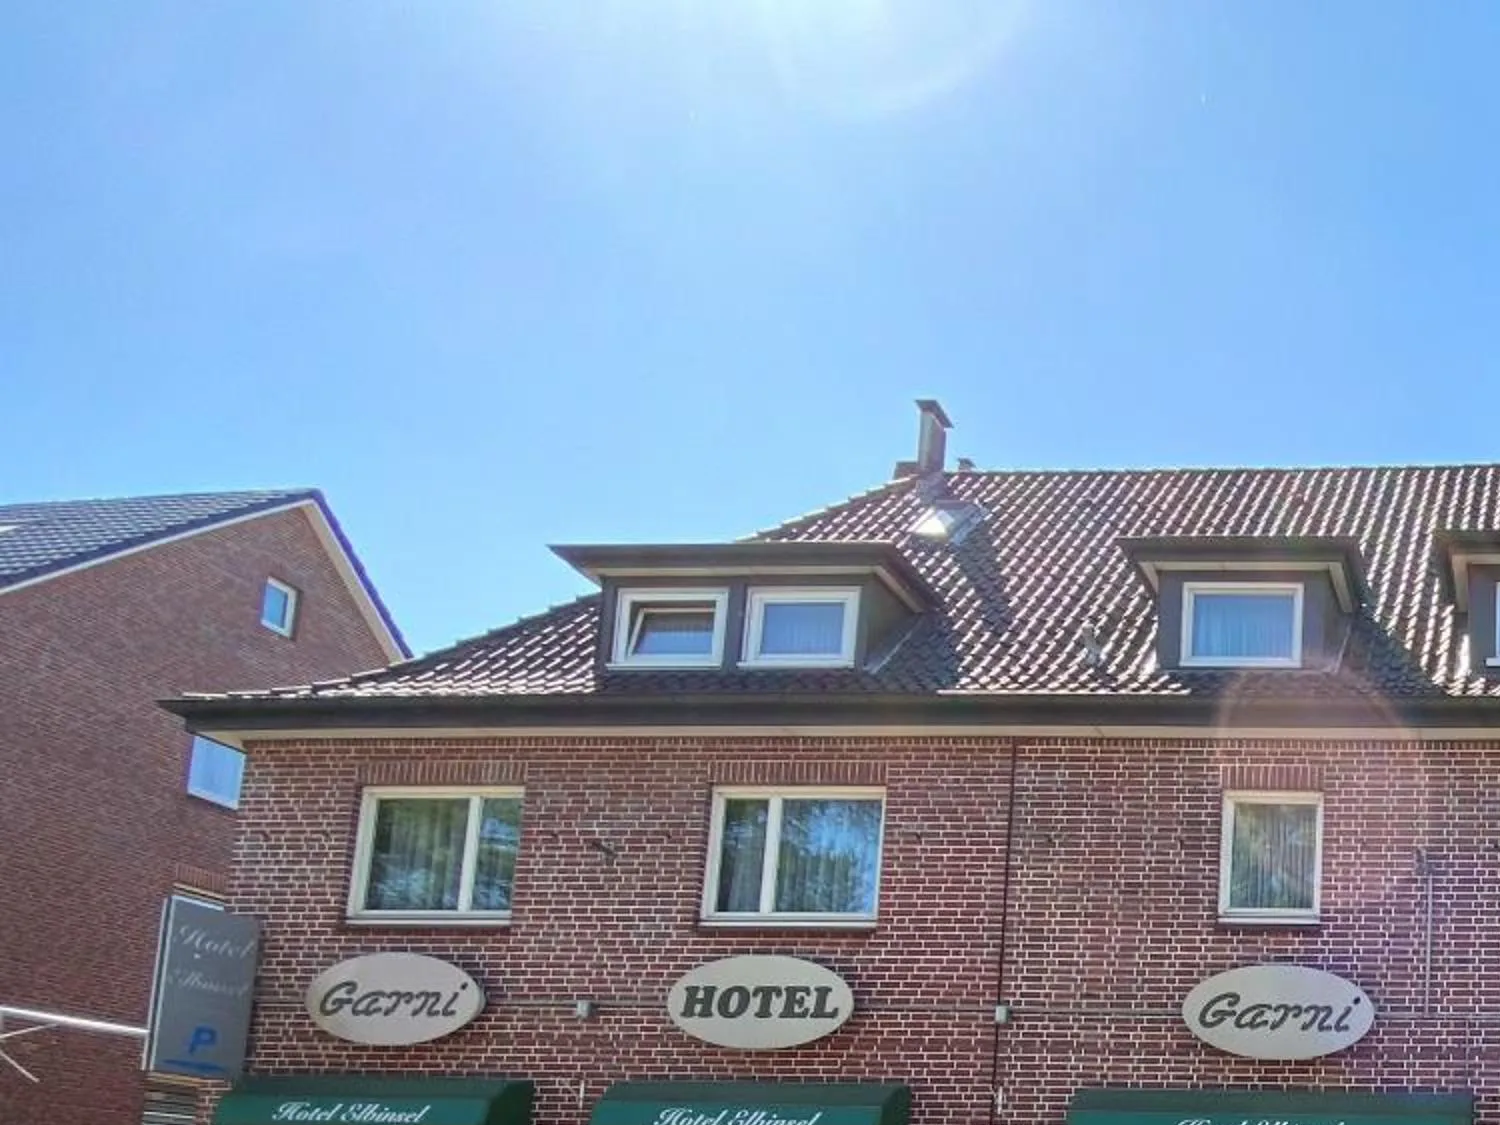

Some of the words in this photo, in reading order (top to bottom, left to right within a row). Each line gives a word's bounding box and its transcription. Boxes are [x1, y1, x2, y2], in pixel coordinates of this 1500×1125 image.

[319, 981, 468, 1016] Garni
[680, 985, 839, 1019] HOTEL
[1198, 992, 1360, 1032] Garni
[189, 1023, 218, 1054] P
[272, 1101, 344, 1121] Hotel
[340, 1103, 431, 1123] Elbinsel
